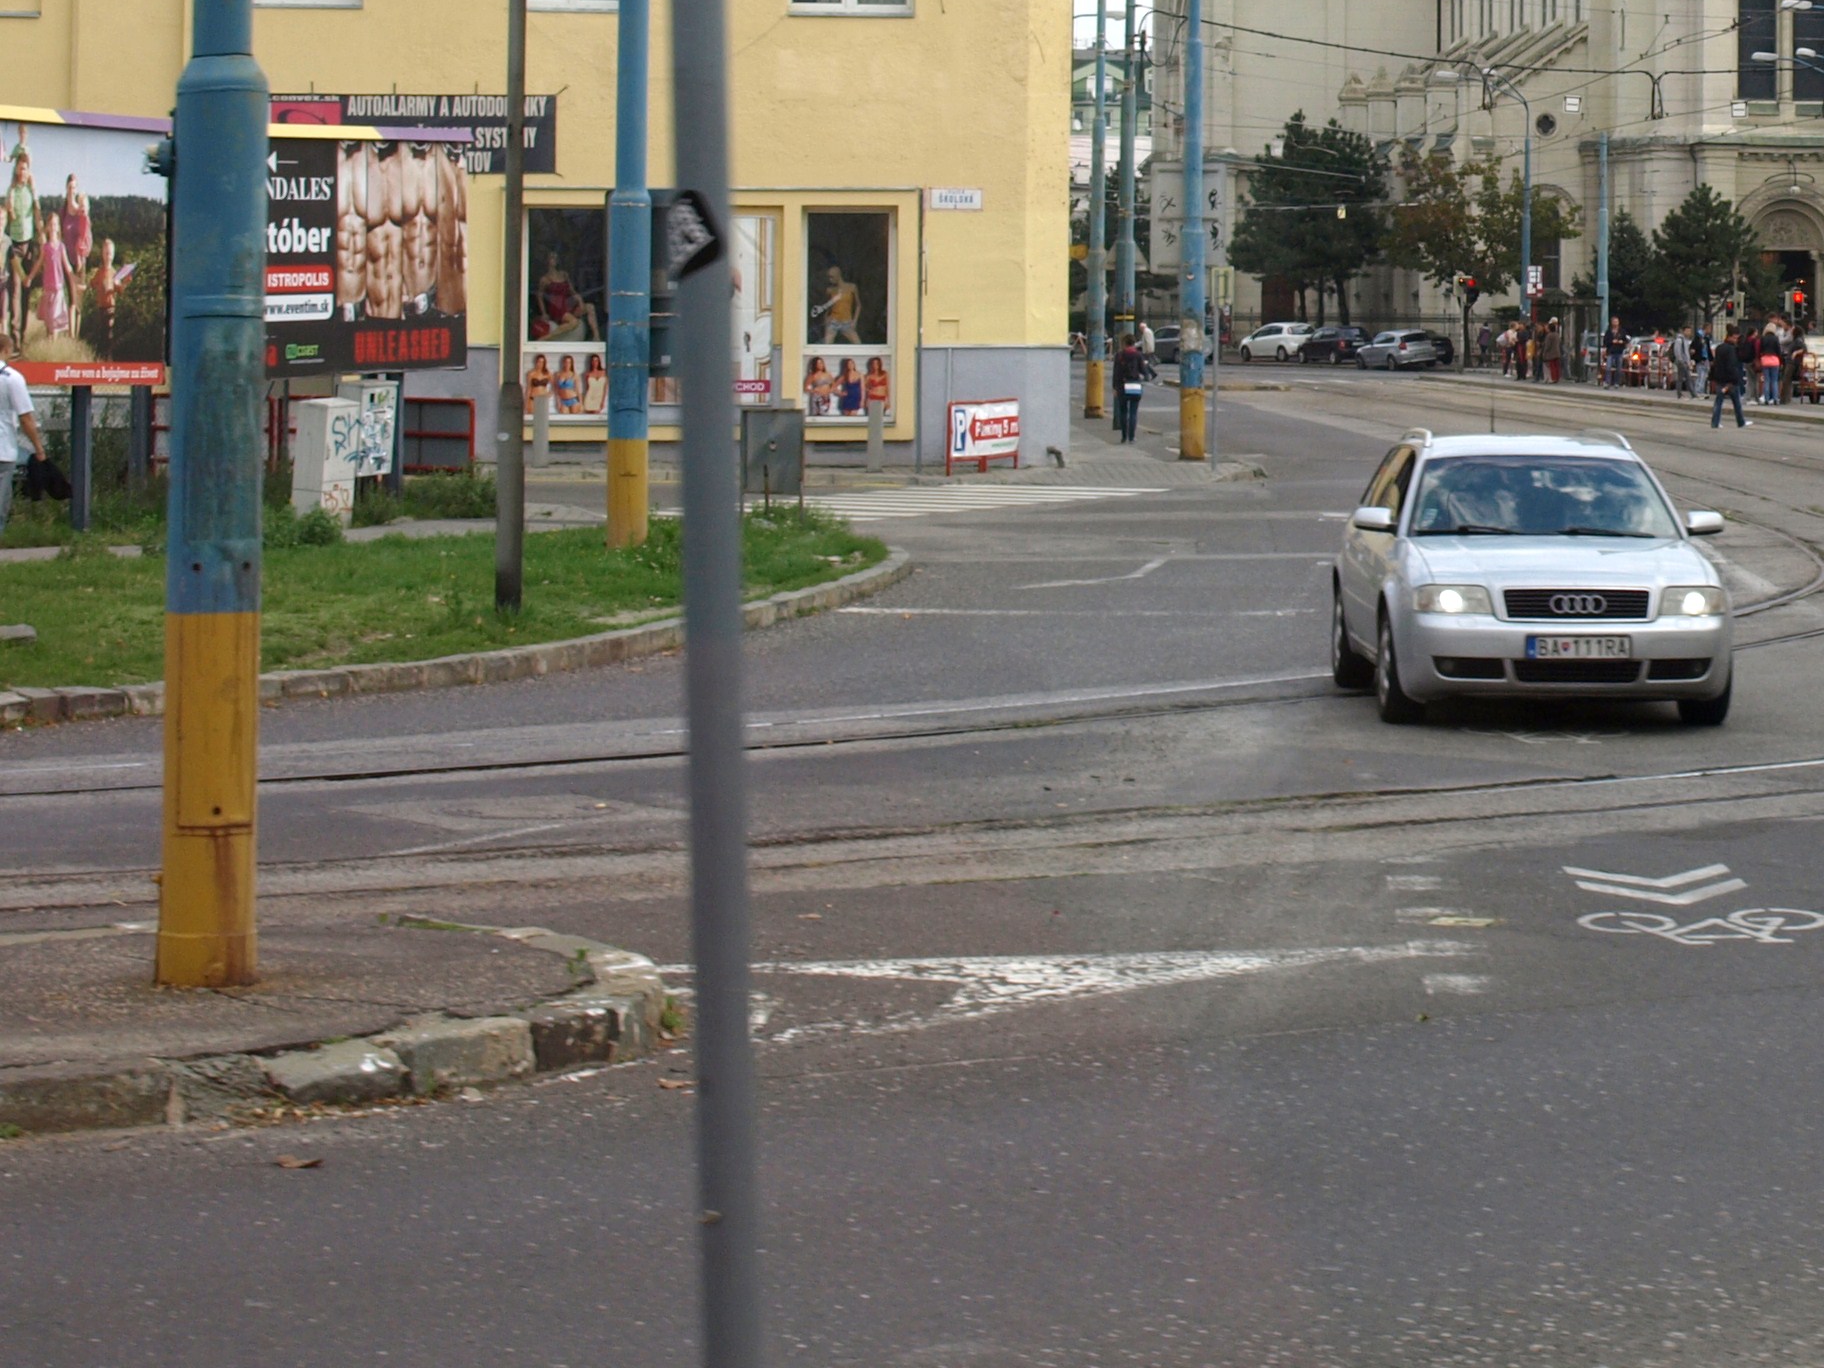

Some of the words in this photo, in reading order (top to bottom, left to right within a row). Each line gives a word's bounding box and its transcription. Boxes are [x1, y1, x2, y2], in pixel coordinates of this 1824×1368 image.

[270, 94, 340, 103] .convex.sk
[347, 95, 437, 118] AUTOALARMY
[439, 96, 451, 118] A
[452, 95, 547, 118] AUTODONKY
[475, 126, 538, 149] SYSTY
[466, 151, 493, 174] TOV
[266, 176, 331, 201] NDALES
[265, 217, 331, 254] tóber
[267, 272, 330, 288] ISTROPOLIS
[353, 328, 451, 365] UNLEASHED
[736, 382, 765, 392] CHOD
[1538, 639, 1560, 656] BA
[1572, 639, 1627, 657] 111RA
